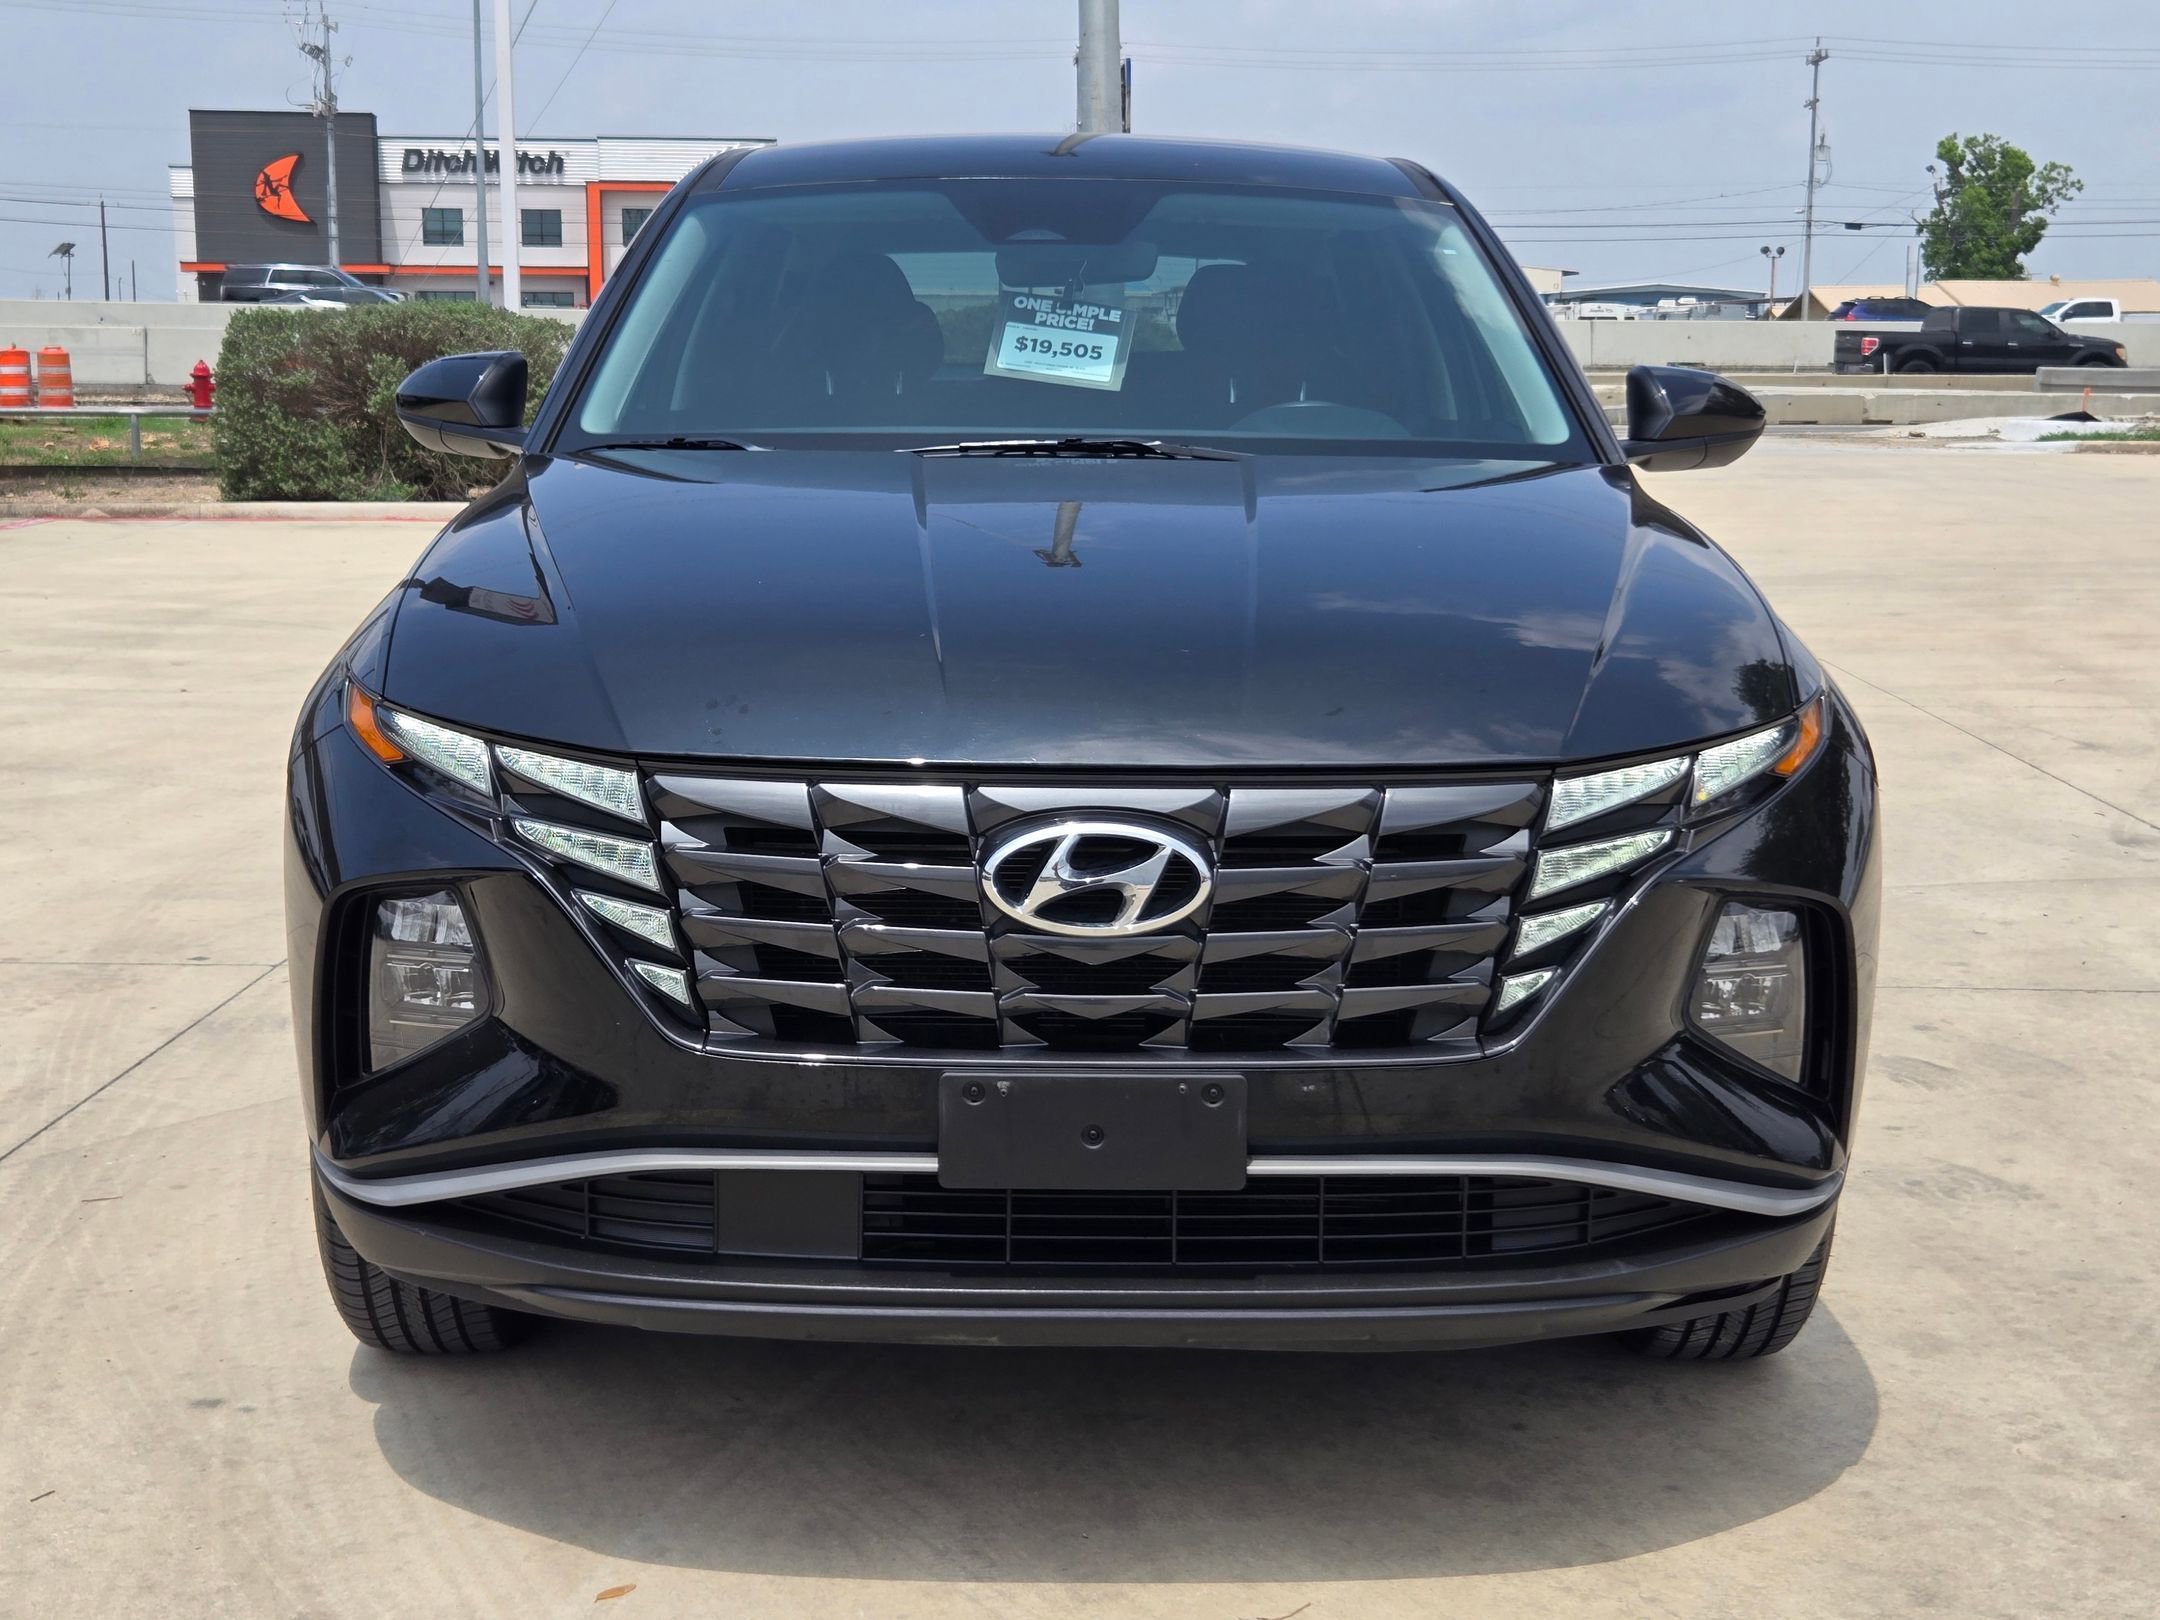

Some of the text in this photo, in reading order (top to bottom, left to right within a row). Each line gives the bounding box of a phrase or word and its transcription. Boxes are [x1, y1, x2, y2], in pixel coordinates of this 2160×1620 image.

[1014, 296, 1122, 322] ONE MPLE
[1034, 312, 1095, 331] PRICE!
[1014, 336, 1103, 360] $19,505
